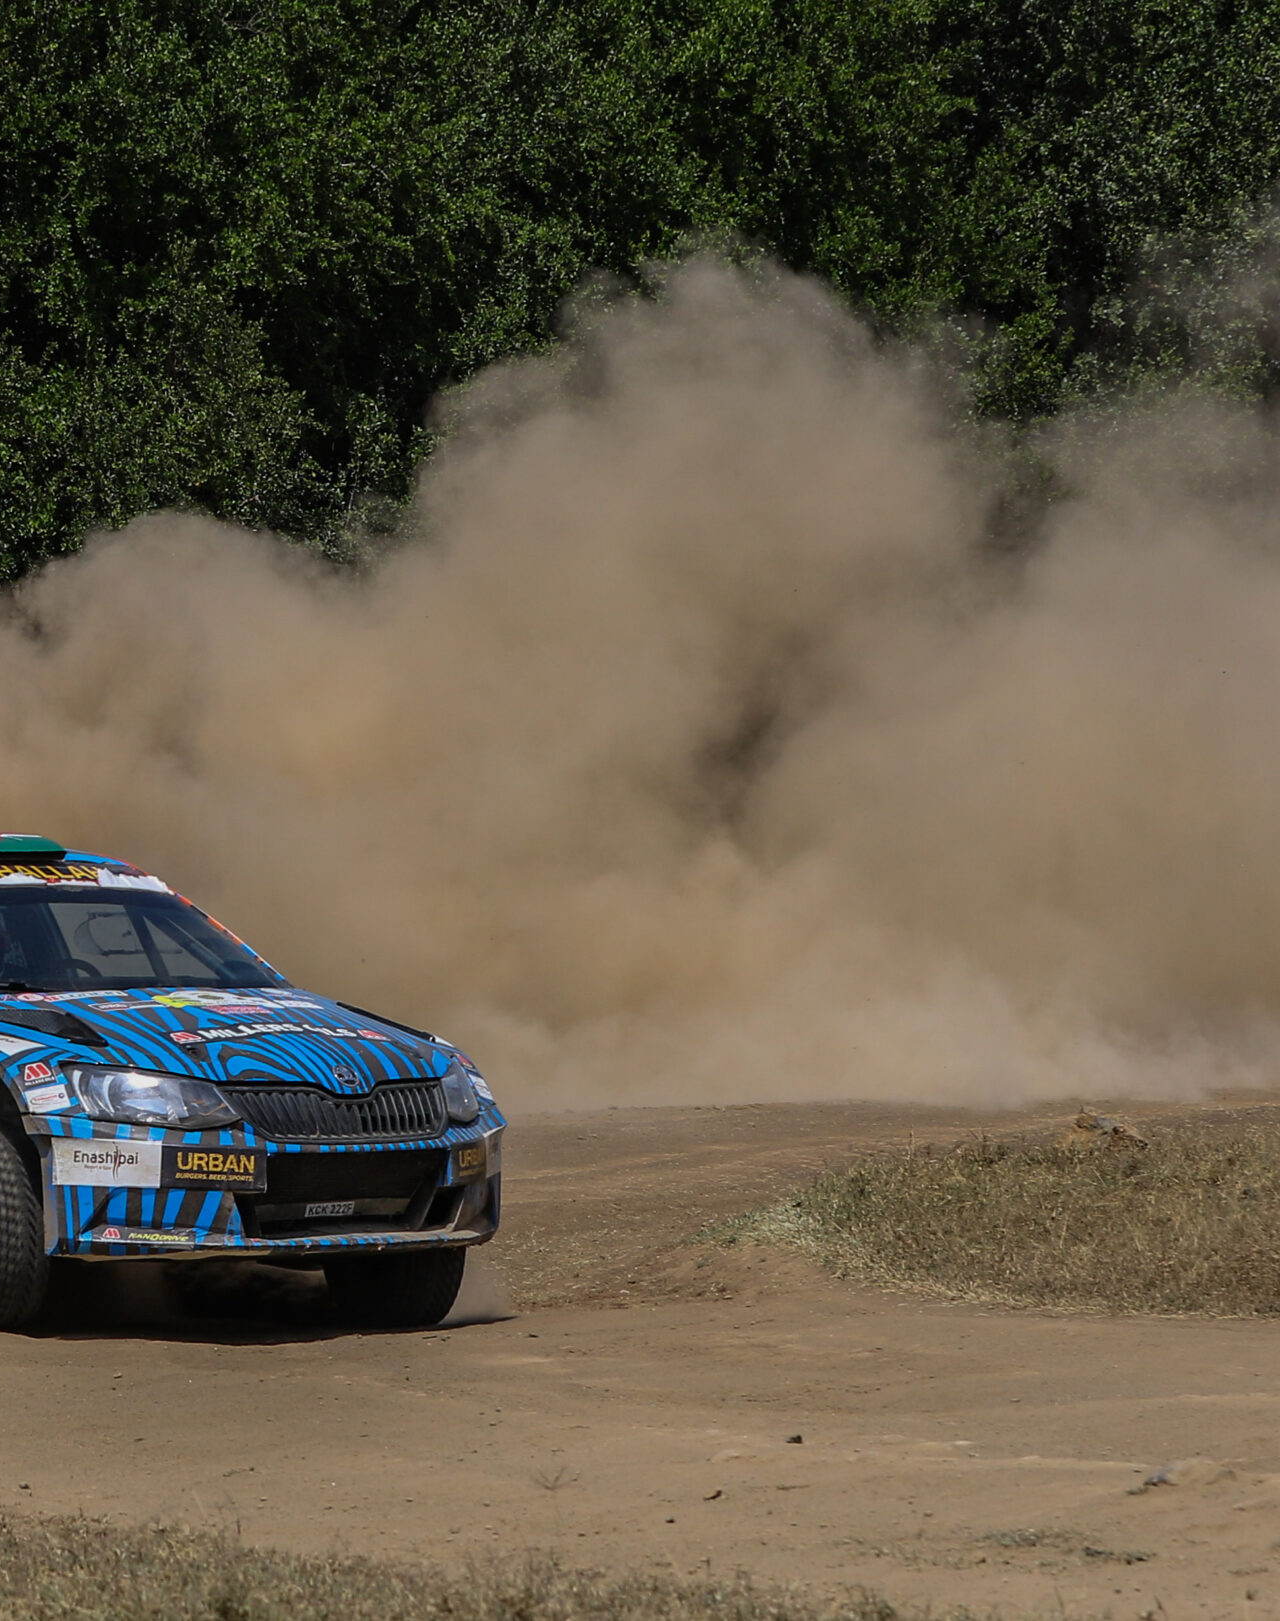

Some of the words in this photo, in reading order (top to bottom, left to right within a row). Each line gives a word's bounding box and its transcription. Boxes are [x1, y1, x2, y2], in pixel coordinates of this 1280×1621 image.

[197, 1024, 304, 1039] MILLERS
[177, 1152, 255, 1173] URBAN
[309, 1204, 329, 1215] KCK
